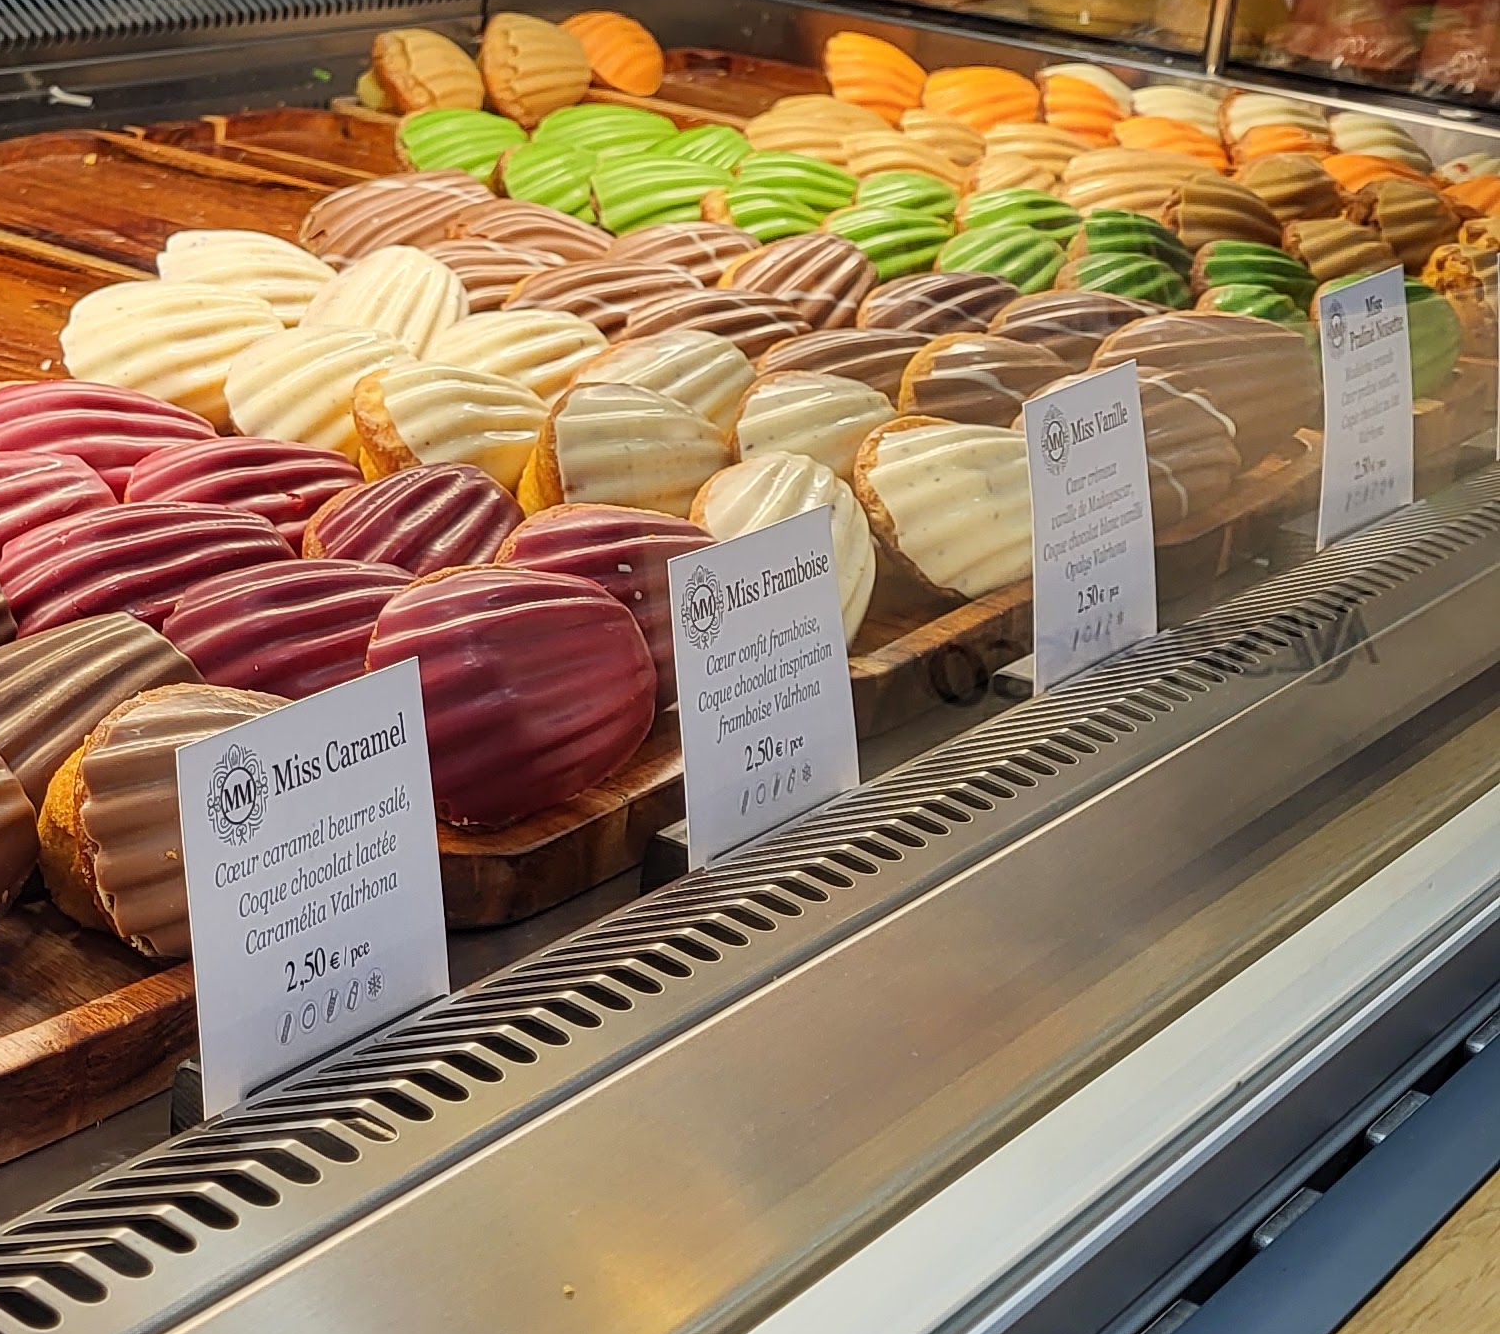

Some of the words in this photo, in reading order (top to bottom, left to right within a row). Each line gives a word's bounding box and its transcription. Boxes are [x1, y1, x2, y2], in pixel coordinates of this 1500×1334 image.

[1071, 417, 1094, 445] Miss
[1094, 401, 1128, 434] Vanille
[726, 579, 760, 612] Miss
[762, 550, 830, 598] Framboise
[698, 681, 732, 713] Coque
[734, 661, 778, 699] chocolat
[779, 642, 832, 679] inspiration
[706, 649, 736, 676] Cœur
[739, 633, 767, 666] confit
[766, 615, 821, 656] framboise,
[717, 696, 772, 744] framboise
[774, 678, 821, 715] Valrhona
[272, 754, 322, 796] Miss
[325, 711, 407, 773] Caramel
[744, 735, 774, 773] 2,50
[214, 855, 259, 889] Cœur
[263, 818, 325, 868] caramel
[328, 802, 377, 841] beurre
[378, 784, 411, 819] salé,
[239, 882, 287, 918] Coque
[291, 849, 353, 893] chocolat
[356, 830, 398, 870] lactée
[245, 901, 326, 957] Caramélia
[330, 869, 398, 925] Valrhona
[284, 946, 326, 993] 2,50
[350, 939, 370, 968] pce
